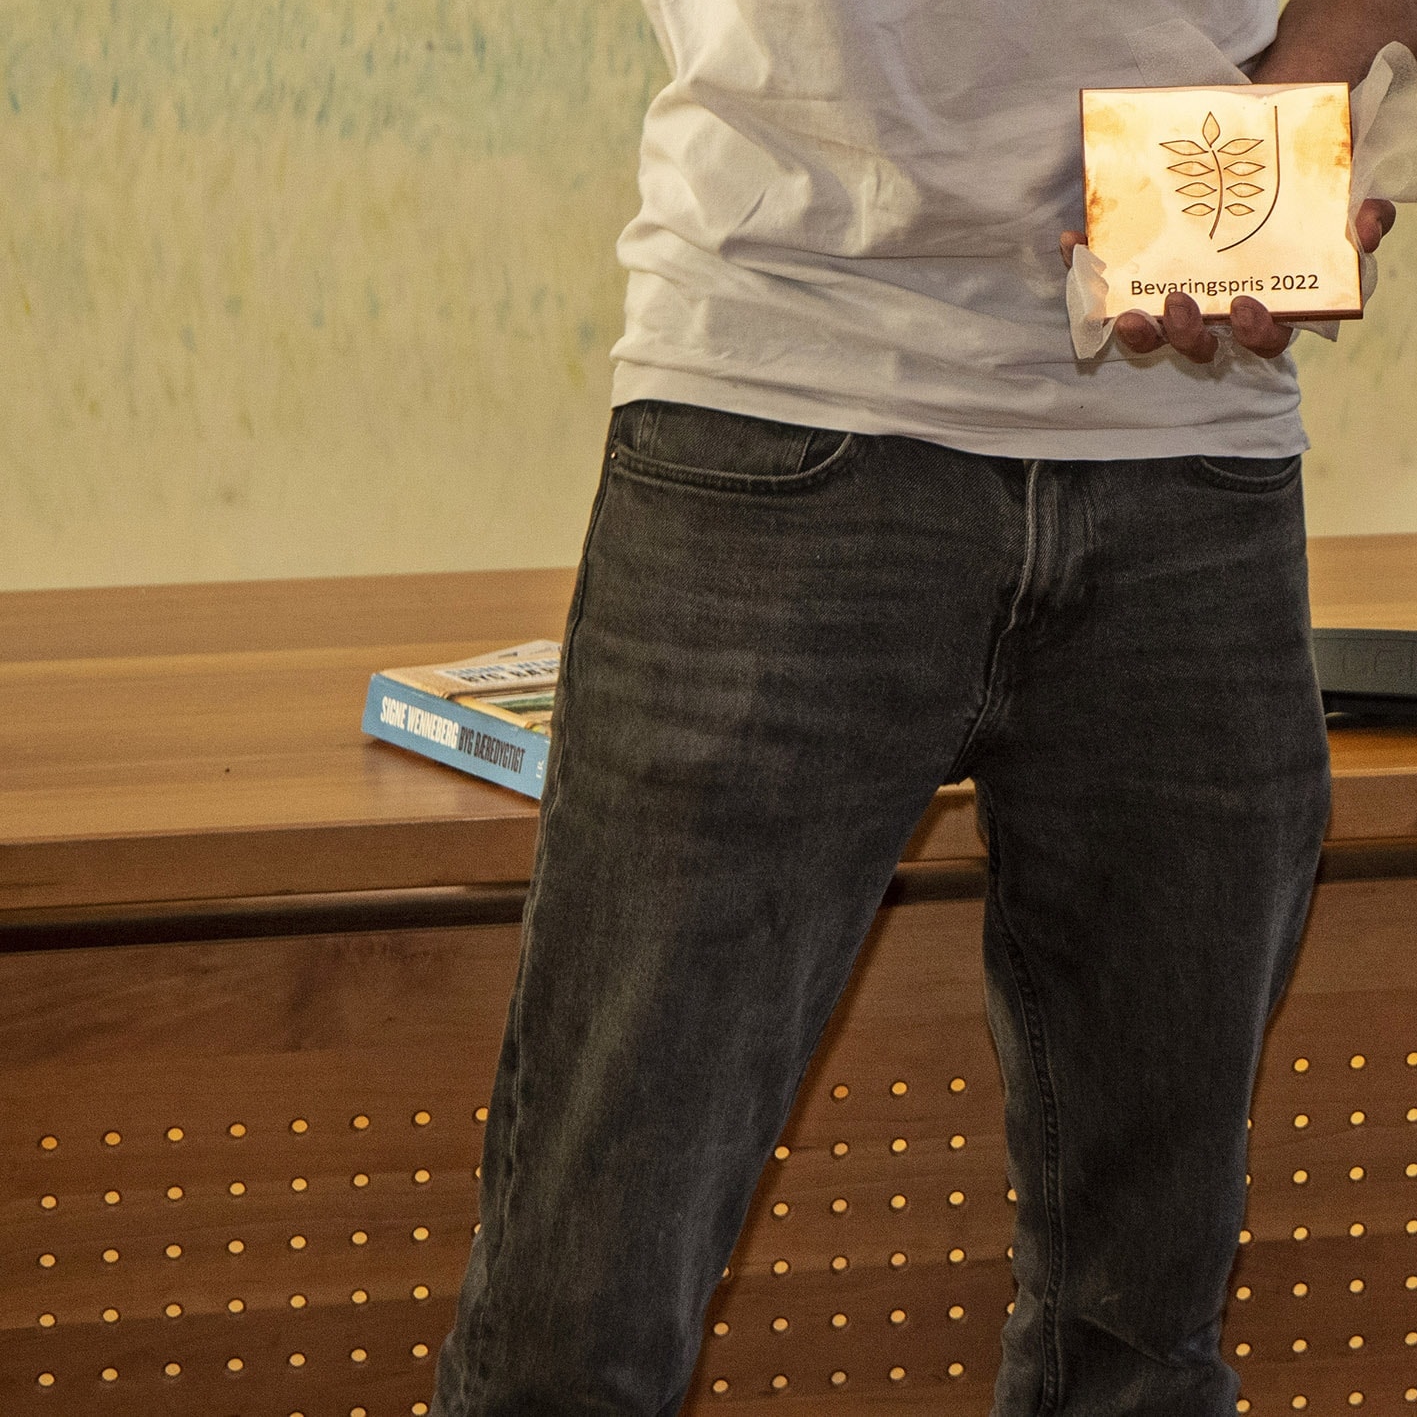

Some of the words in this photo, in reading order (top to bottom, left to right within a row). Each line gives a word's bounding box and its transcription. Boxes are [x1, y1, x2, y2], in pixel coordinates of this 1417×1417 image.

[1131, 276, 1264, 296] Bevaringspris
[1270, 274, 1320, 291] 2022
[380, 695, 407, 730] SIGNE
[406, 704, 459, 750] WENNEBERG
